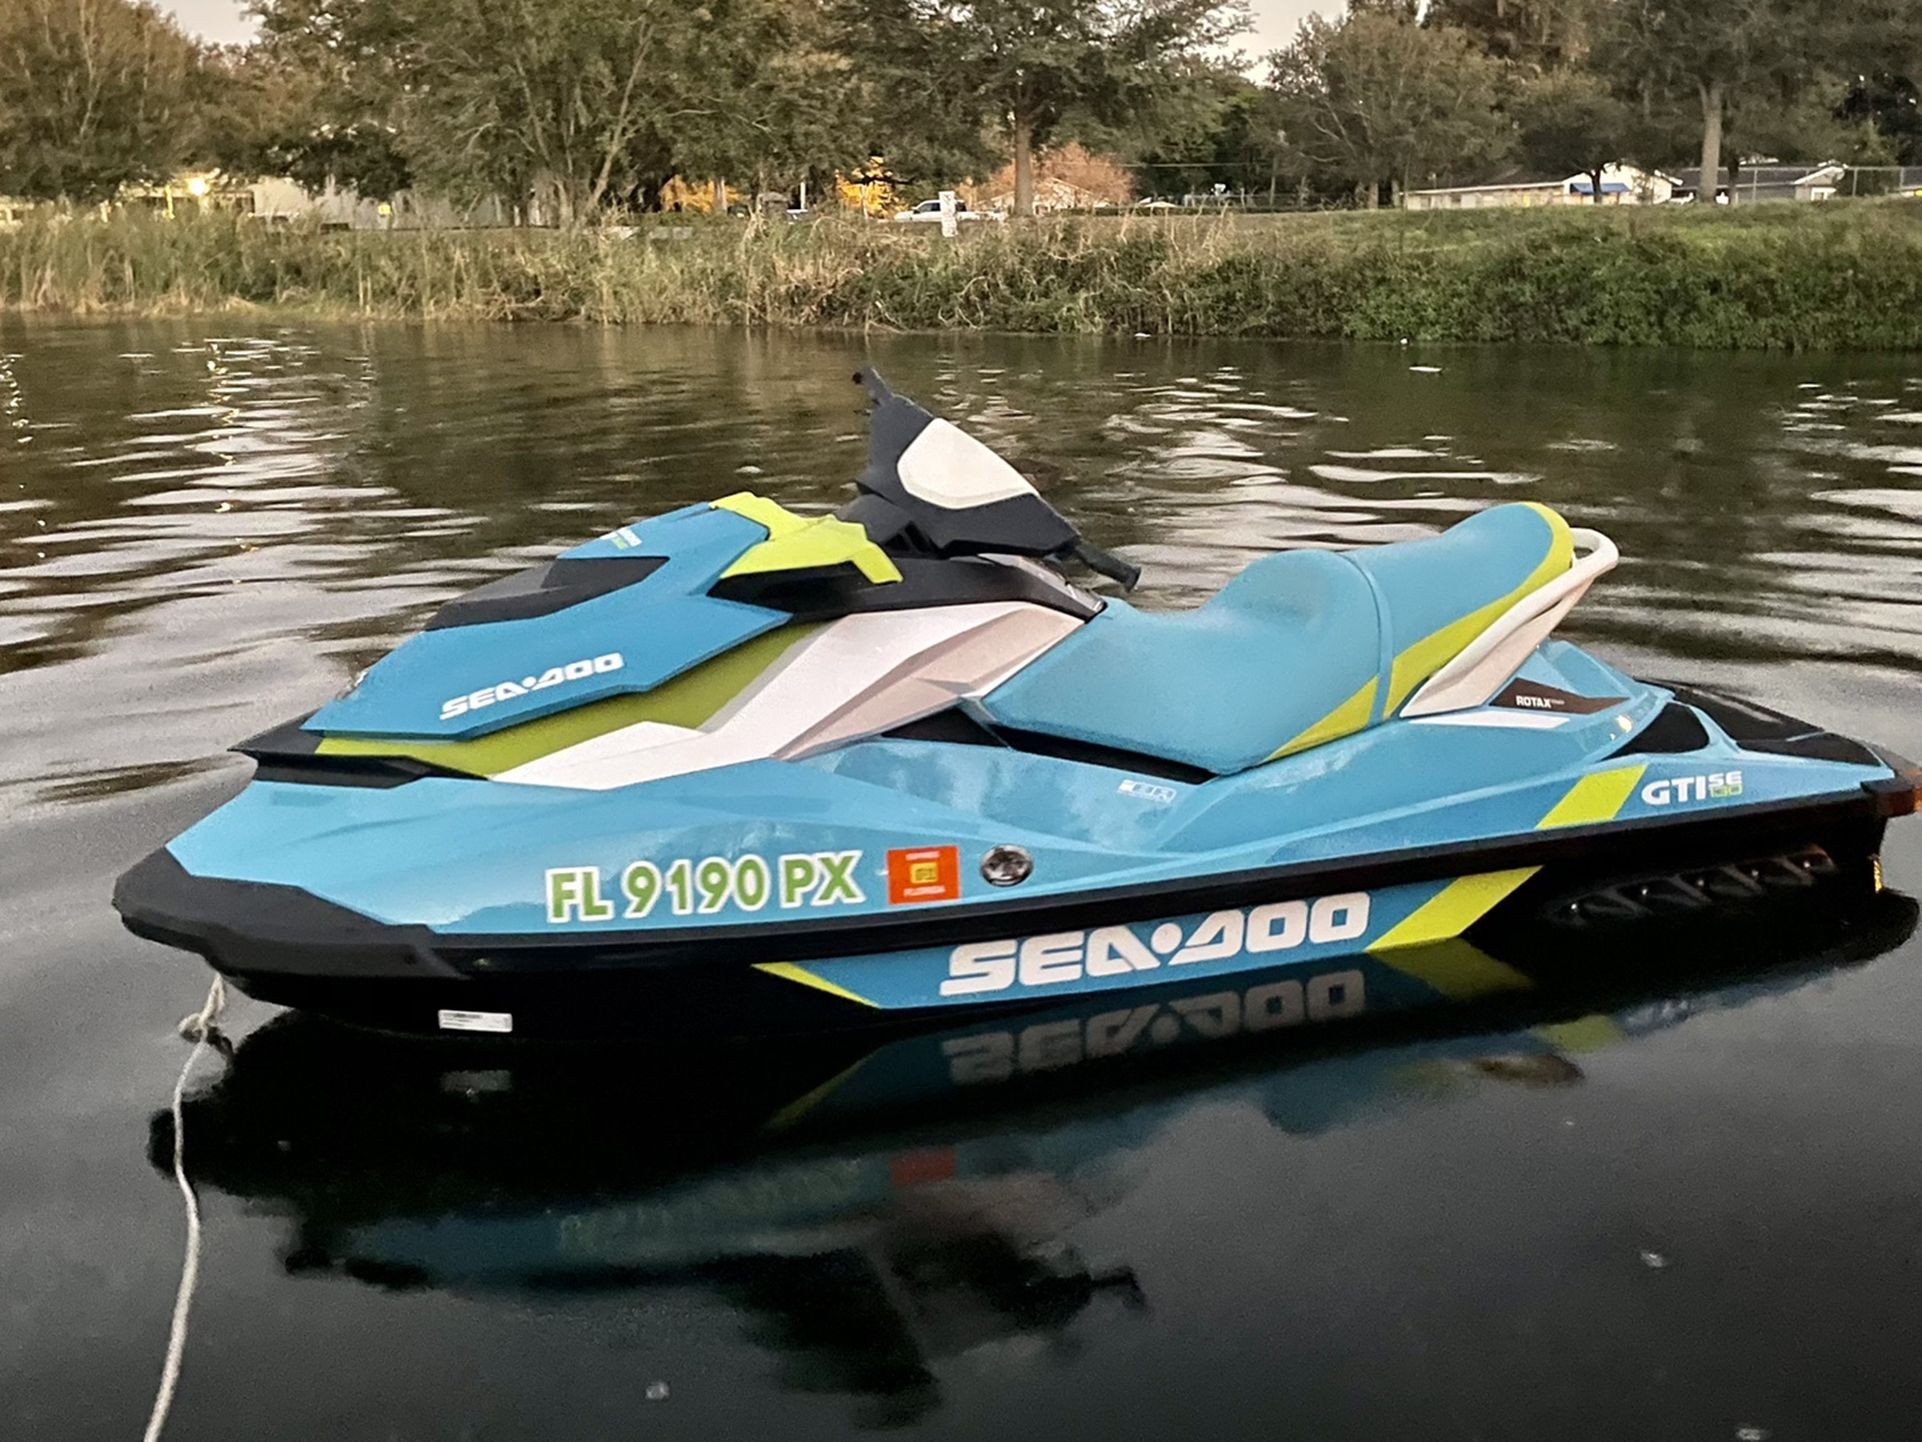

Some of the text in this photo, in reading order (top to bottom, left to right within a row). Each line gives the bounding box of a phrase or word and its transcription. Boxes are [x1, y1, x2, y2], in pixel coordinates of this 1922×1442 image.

[1515, 694, 1552, 708] ROTAX
[1641, 770, 1743, 805] GTI SE
[546, 850, 866, 923] FL 9190 PX
